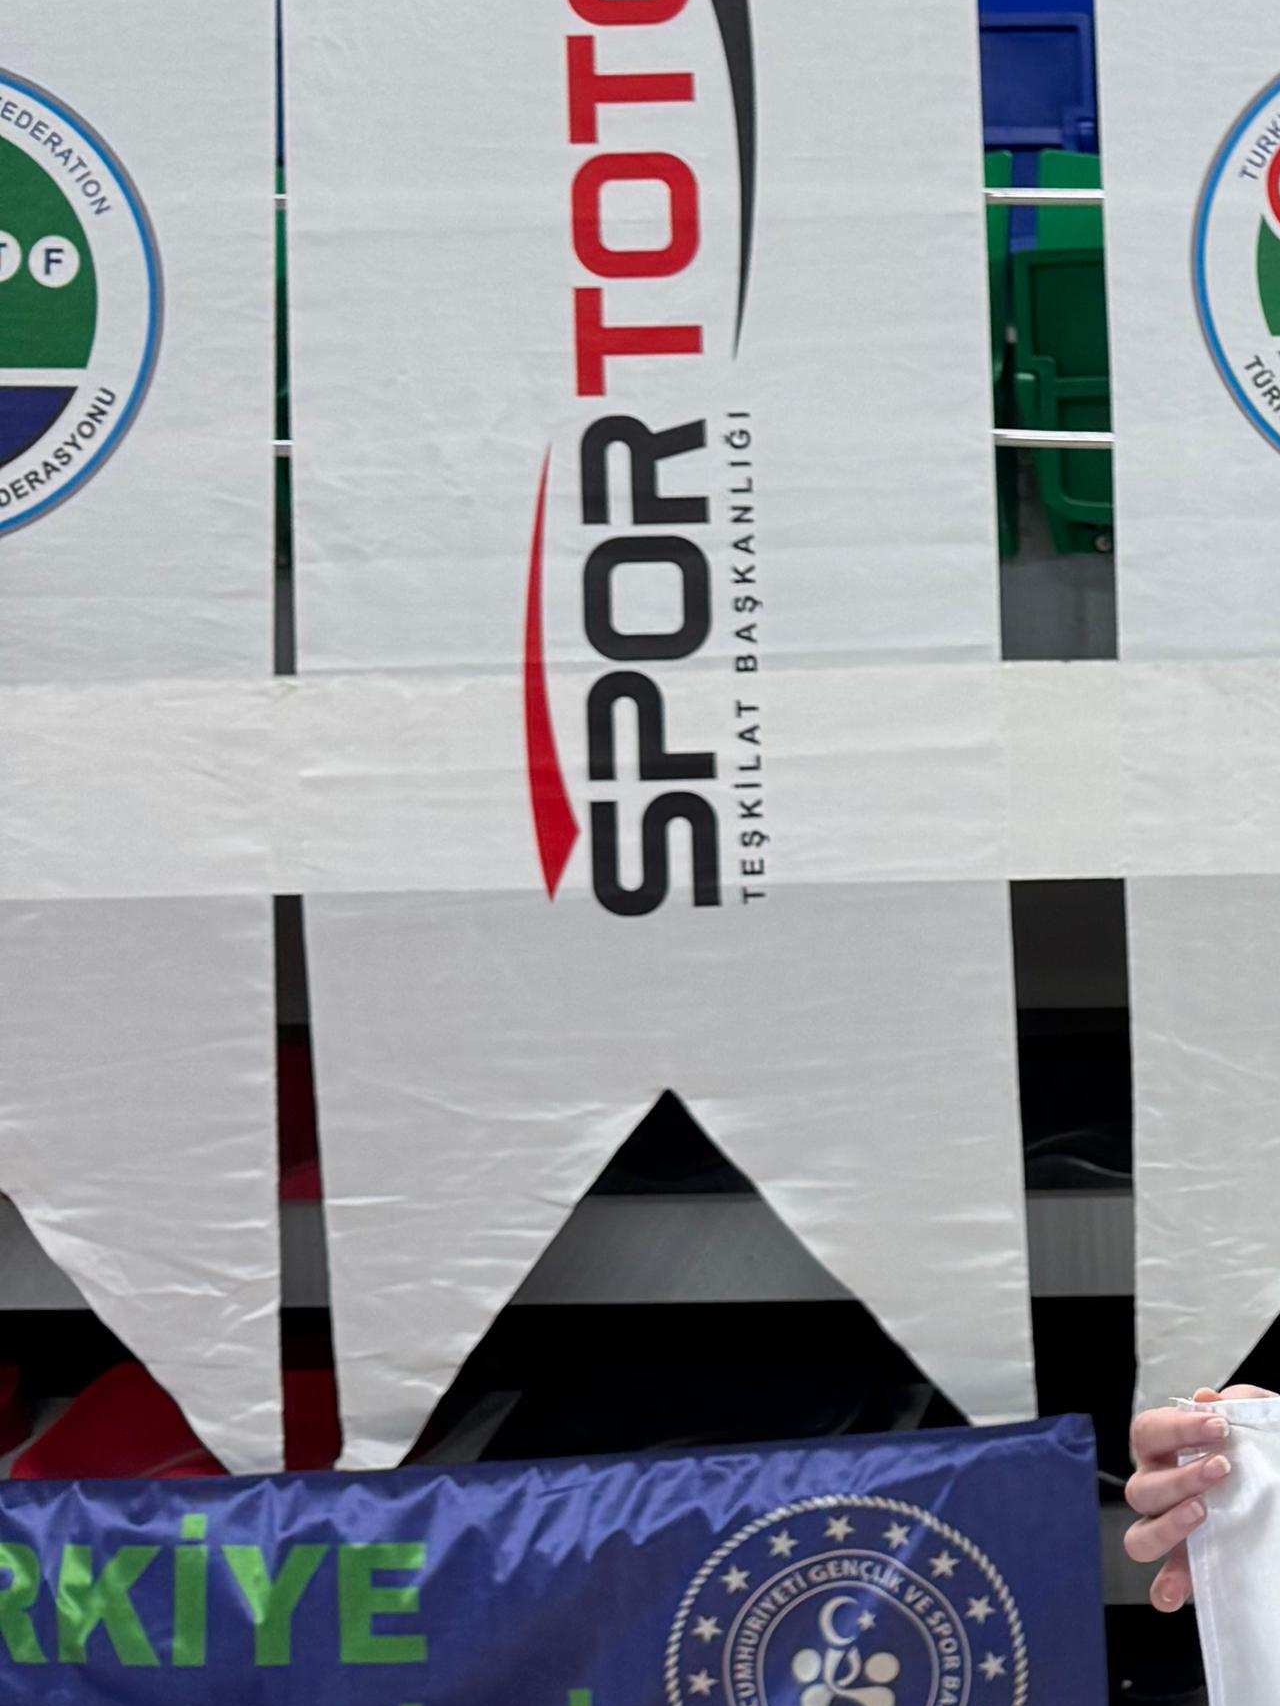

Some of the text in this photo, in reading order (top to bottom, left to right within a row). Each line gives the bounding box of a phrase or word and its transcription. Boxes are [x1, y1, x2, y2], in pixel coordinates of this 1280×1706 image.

[0, 97, 111, 216] EDERATION
[725, 411, 771, 905] TEŞKİLAT BAŞKANLIĞI
[807, 1558, 906, 1593] GENÇLİK
[903, 1584, 933, 1613] VE
[925, 1609, 963, 1679] SPOR
